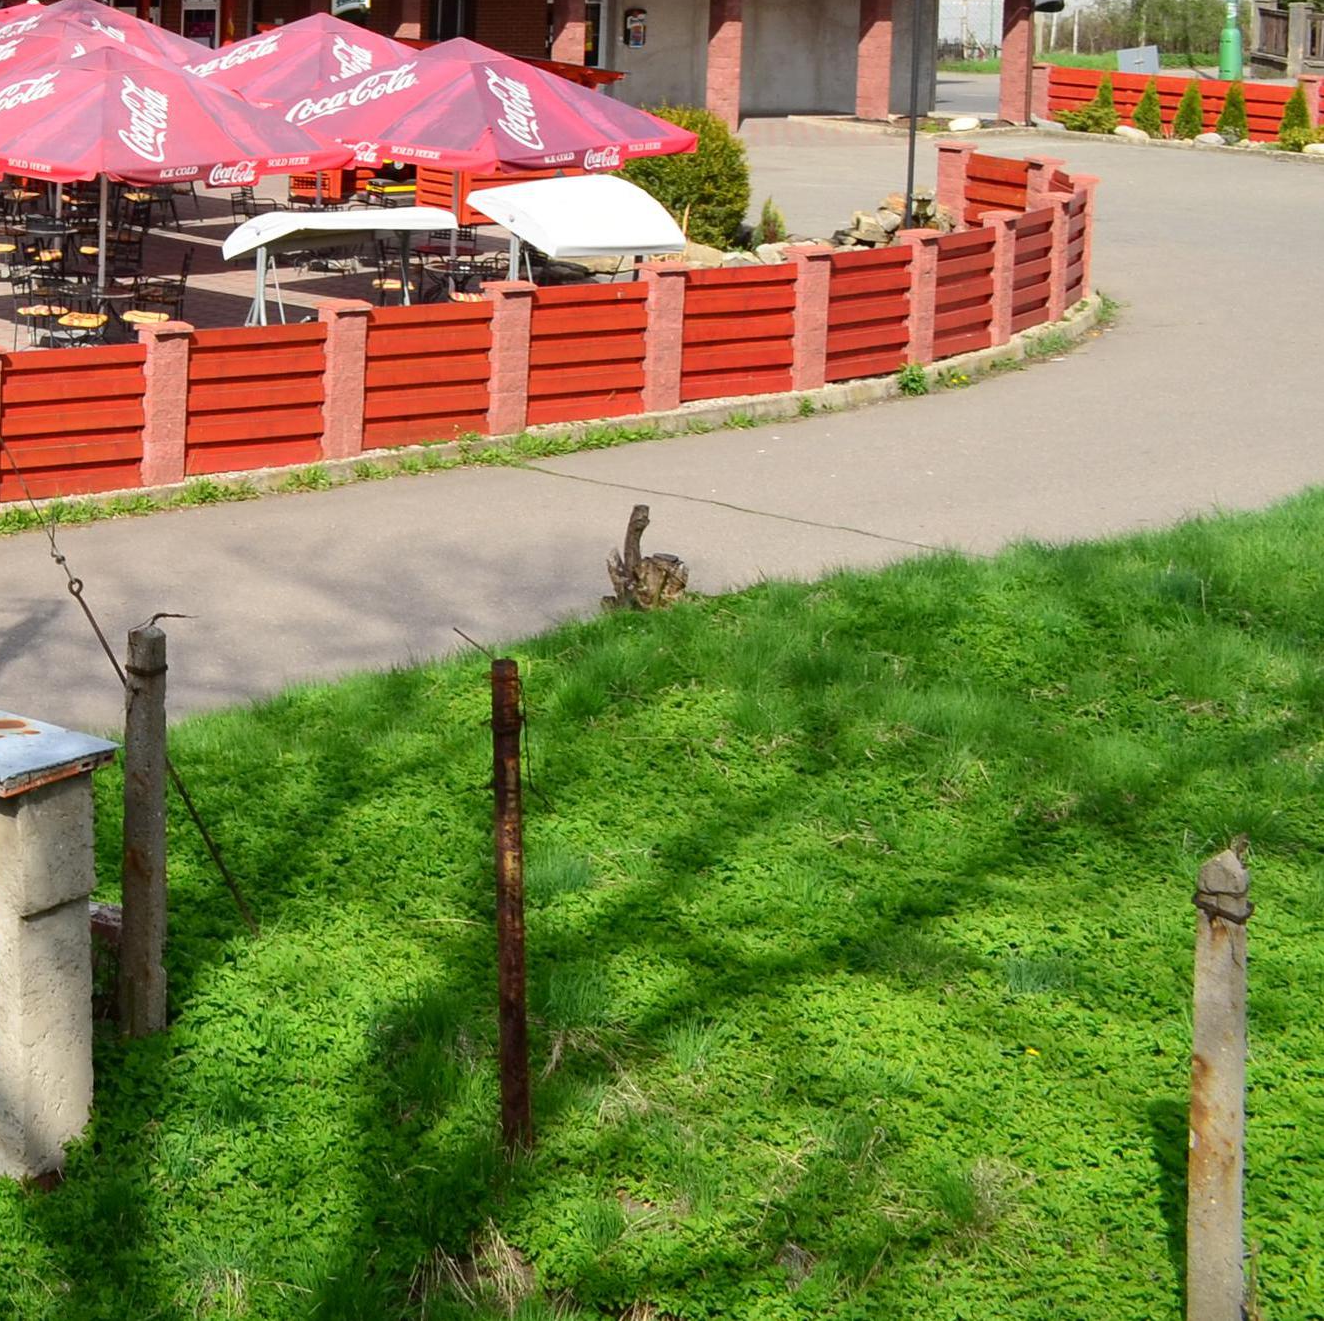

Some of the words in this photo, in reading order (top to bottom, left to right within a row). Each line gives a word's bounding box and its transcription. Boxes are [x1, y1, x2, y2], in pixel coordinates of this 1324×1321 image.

[391, 145, 414, 156] SOLD
[414, 149, 441, 160] HERE
[543, 155, 555, 164] ICE
[556, 152, 575, 162] COLD
[8, 157, 28, 169] SOLD
[267, 158, 288, 167] SOLD
[159, 168, 174, 178] ICE
[175, 166, 199, 177] COLD
